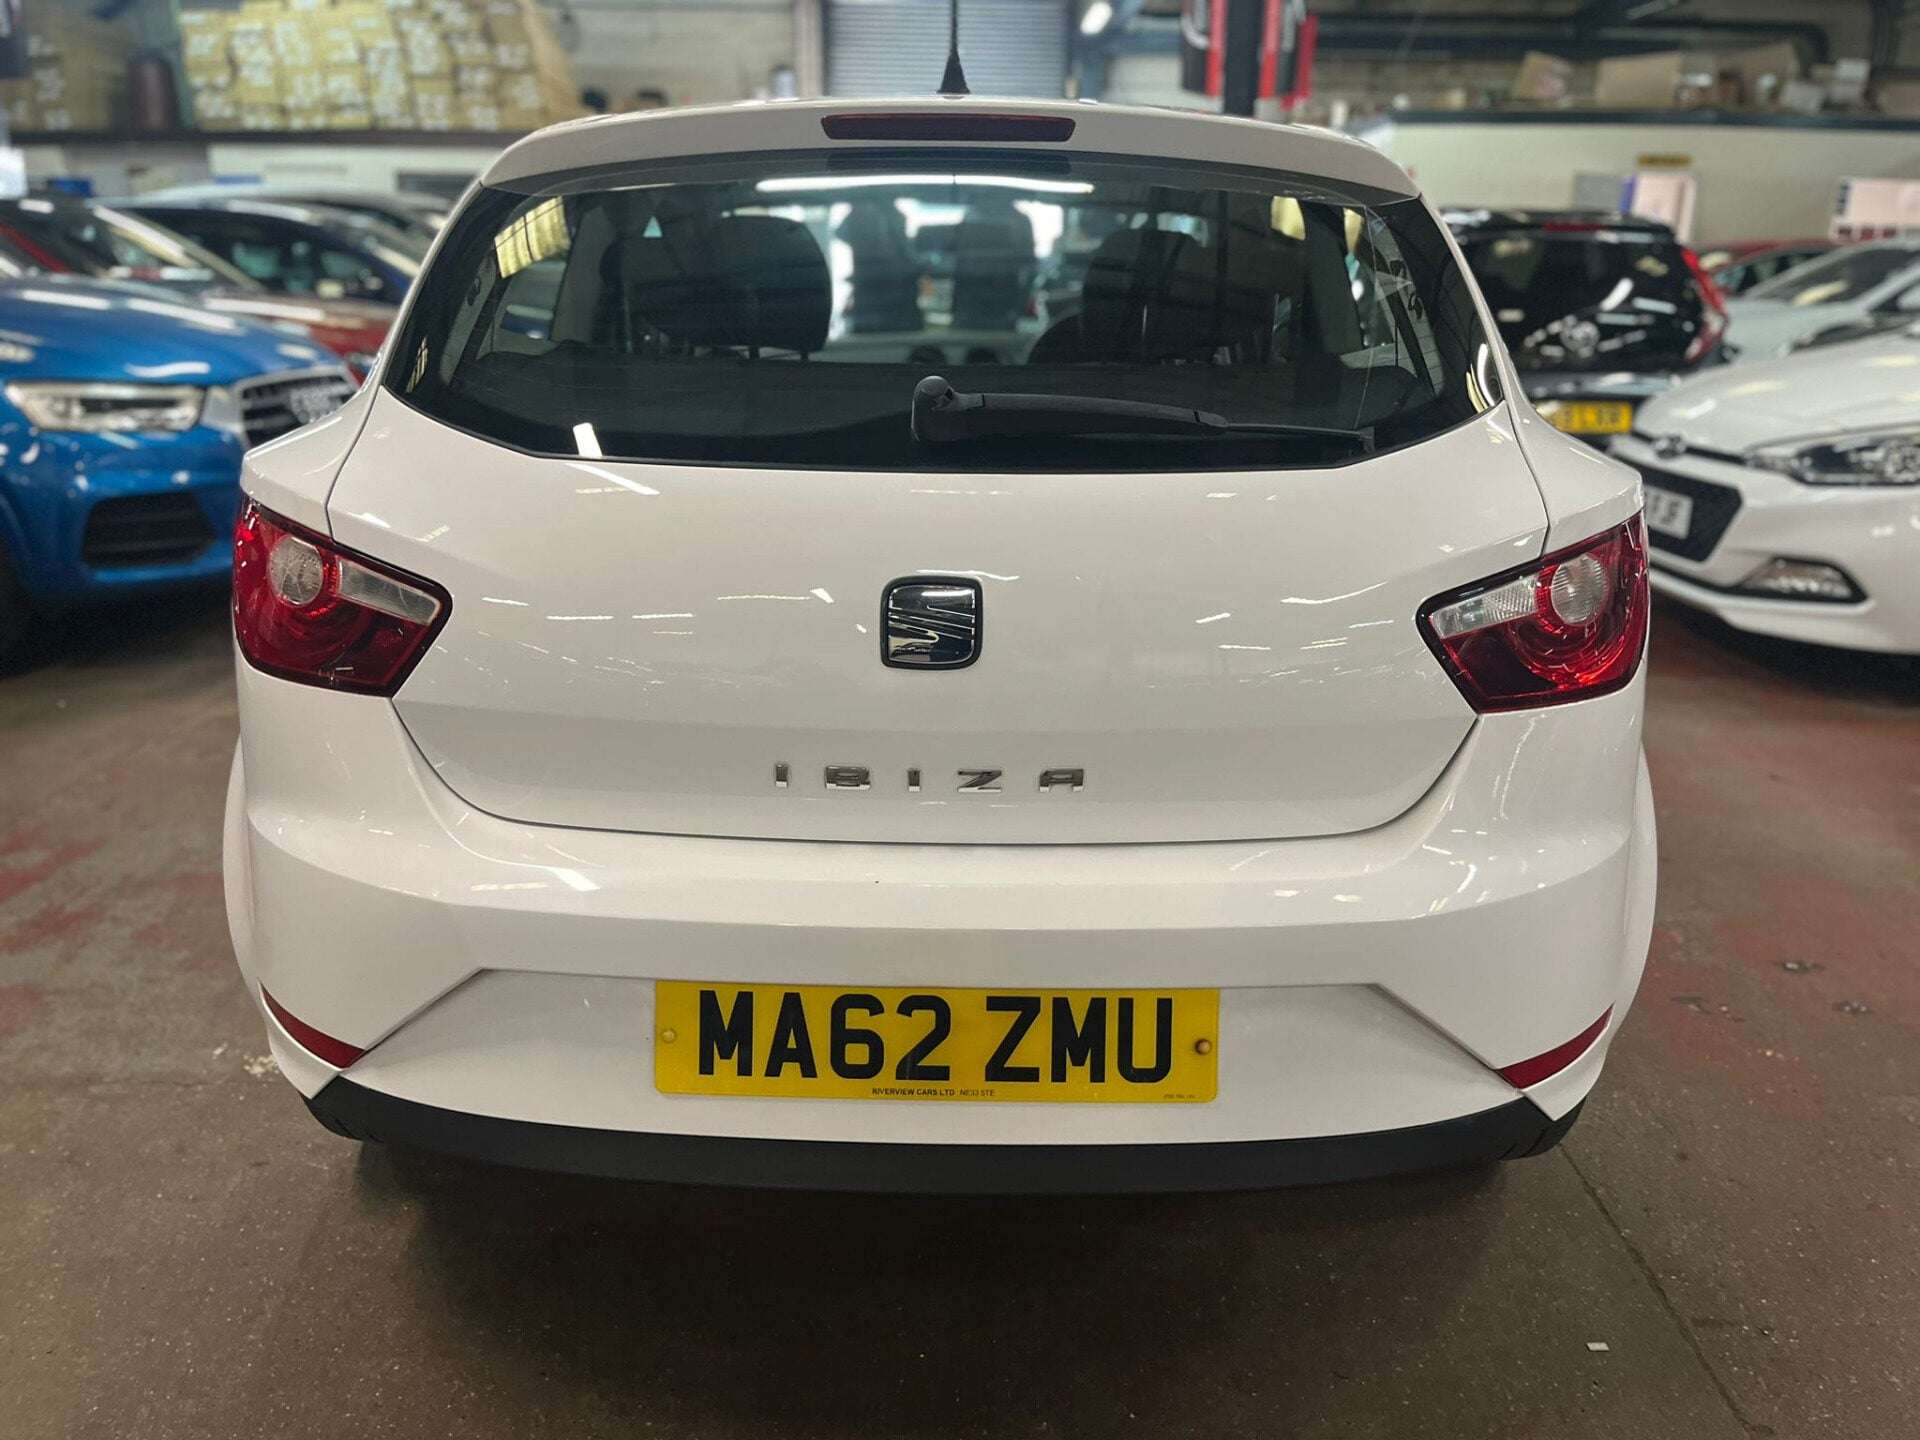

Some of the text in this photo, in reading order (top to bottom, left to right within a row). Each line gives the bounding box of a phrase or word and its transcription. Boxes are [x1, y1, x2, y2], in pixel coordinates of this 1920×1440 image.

[773, 763, 1085, 792] IBIZA
[698, 989, 1173, 1084] MA62 ZMU
[871, 1087, 914, 1096] RIVERVIEW
[916, 1087, 938, 1097] CARS
[939, 1088, 955, 1097] LTD
